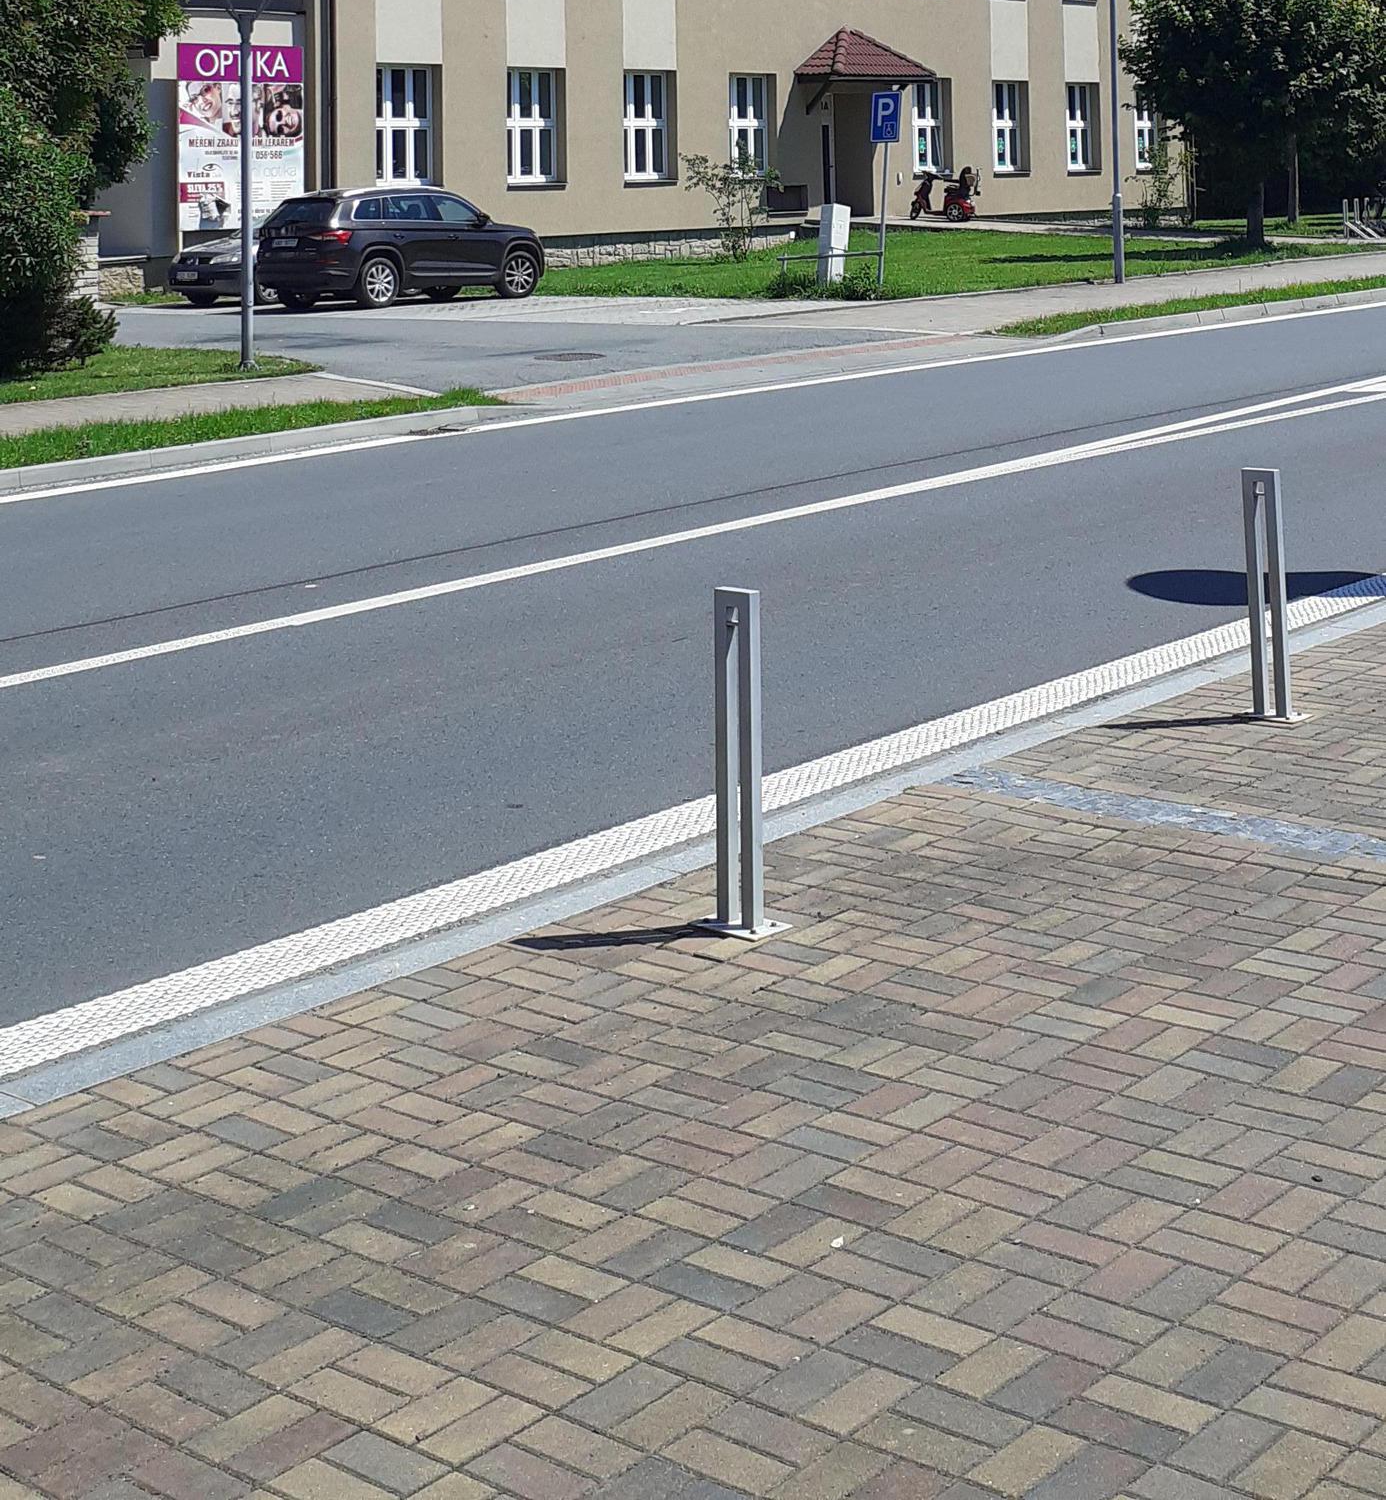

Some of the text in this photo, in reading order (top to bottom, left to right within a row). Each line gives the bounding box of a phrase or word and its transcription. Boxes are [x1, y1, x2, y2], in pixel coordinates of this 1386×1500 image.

[195, 48, 290, 78] OPTIKA
[877, 98, 895, 127] P
[216, 138, 239, 148] ZRAKU
